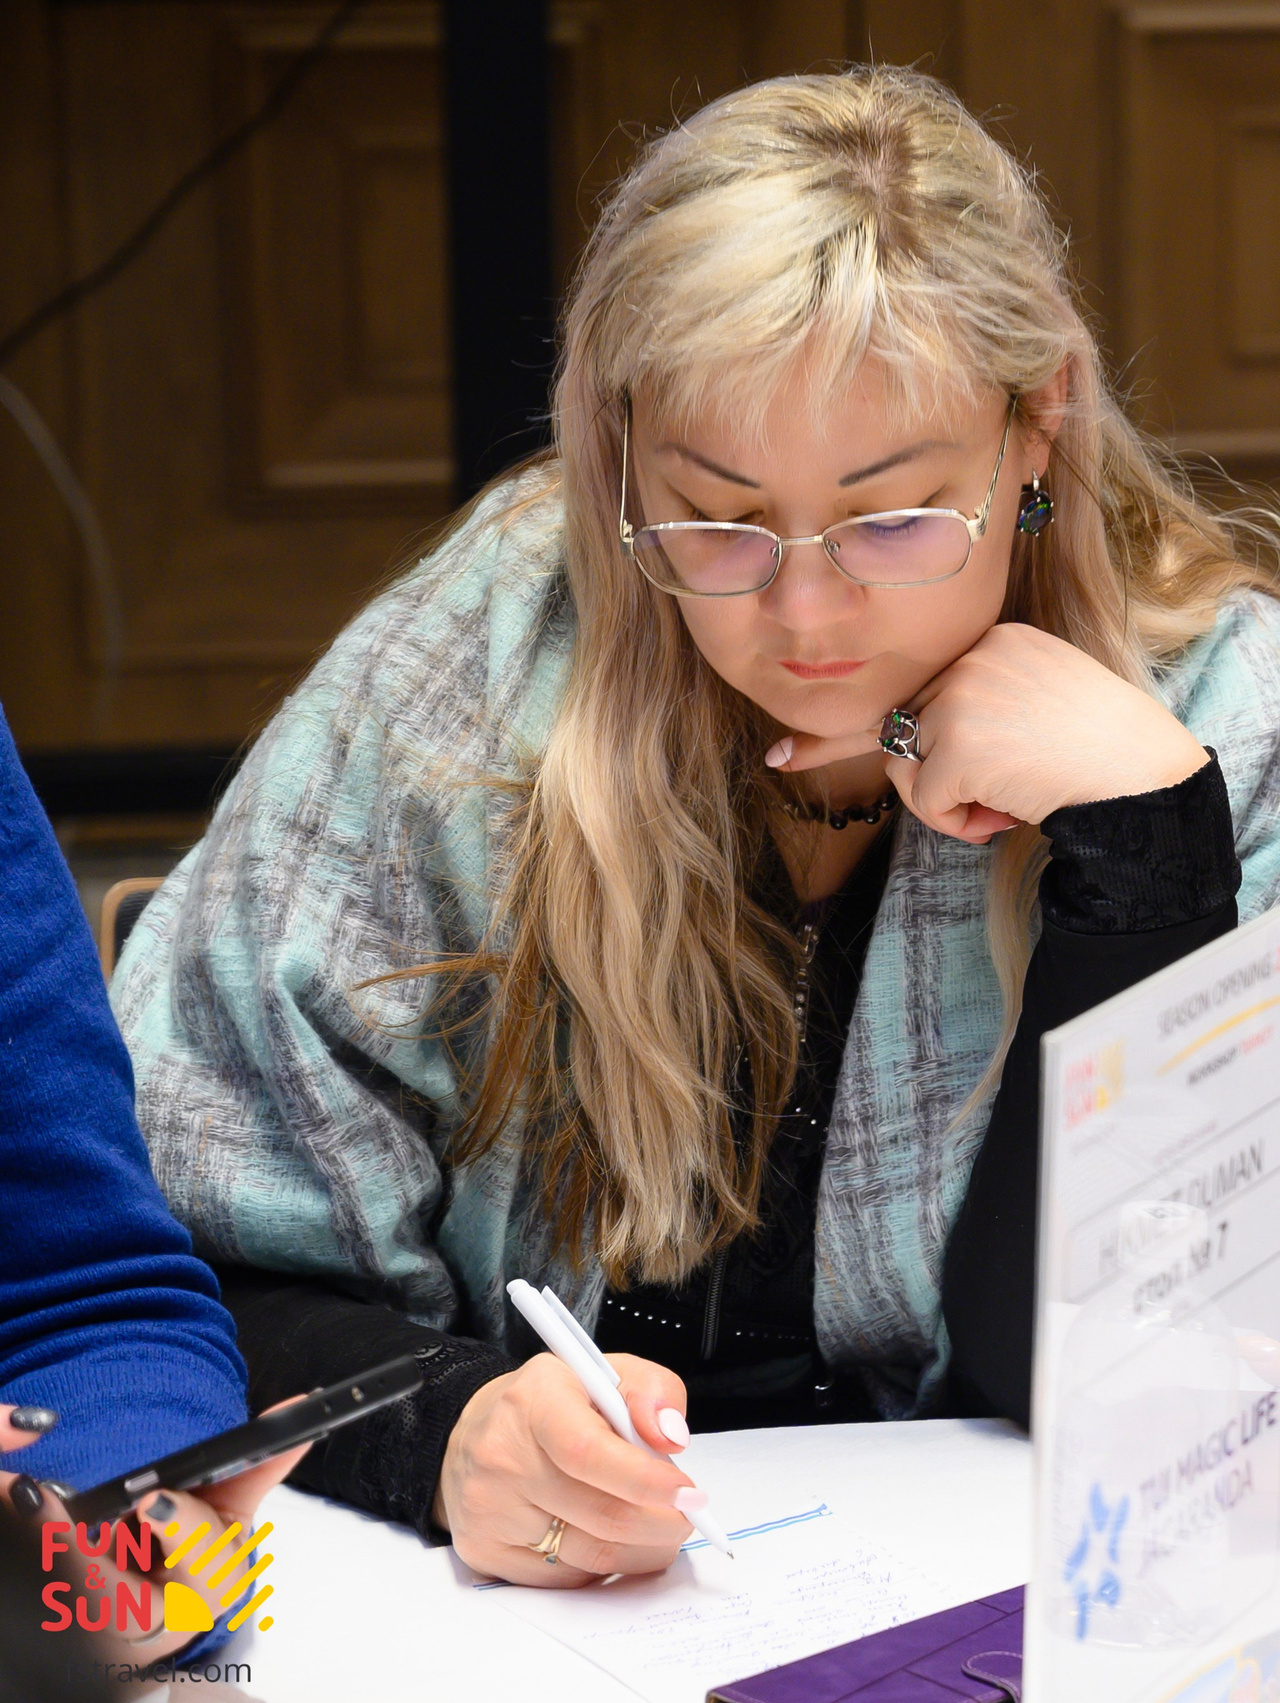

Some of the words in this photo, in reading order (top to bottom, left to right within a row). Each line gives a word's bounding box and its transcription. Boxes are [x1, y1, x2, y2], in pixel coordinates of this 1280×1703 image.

[1187, 1138, 1265, 1206] DUMAN
[1217, 1220, 1229, 1259] 7
[1177, 1419, 1237, 1494] MAGIC
[1241, 1390, 1278, 1446] LIFE
